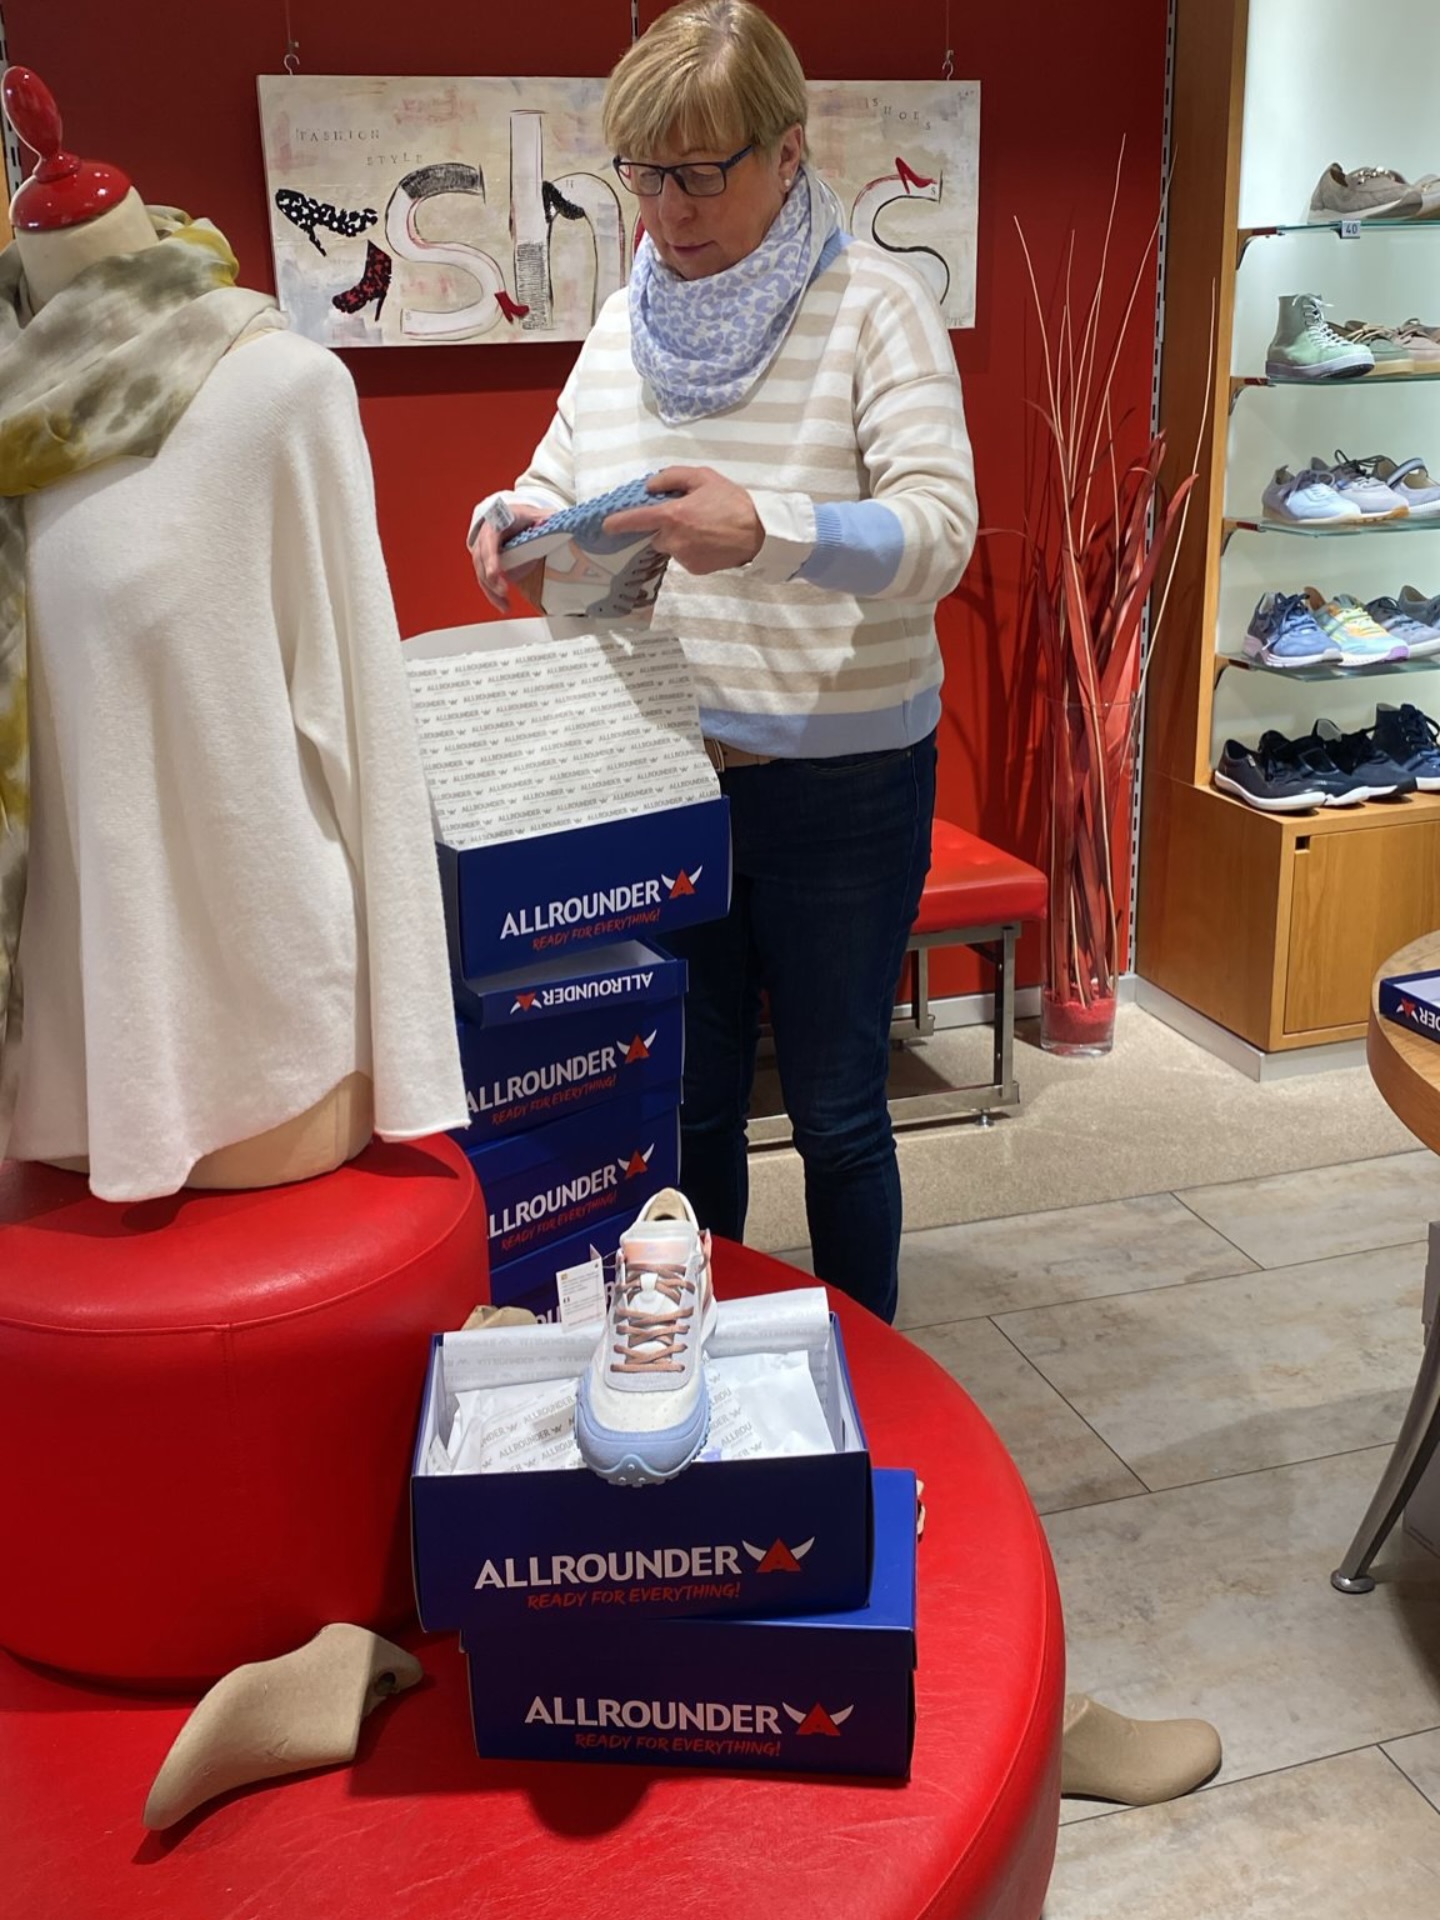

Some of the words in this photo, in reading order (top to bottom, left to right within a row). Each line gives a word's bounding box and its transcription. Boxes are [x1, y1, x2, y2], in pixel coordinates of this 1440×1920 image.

[1345, 223, 1358, 234] 40
[500, 879, 661, 940] ALLROUNDER
[532, 931, 569, 951] READY
[572, 926, 592, 940] FOR
[594, 909, 660, 936] EVERYTHING!
[542, 972, 653, 1006] ALLROUNDER
[467, 1046, 617, 1114] ALLROUNDER
[492, 1107, 527, 1125] READY
[531, 1097, 549, 1111] FOR
[550, 1074, 617, 1106] EVERYTHING!
[488, 1164, 618, 1240] LLROUNDER
[474, 1545, 742, 1590] ALLROUNDER
[527, 1592, 586, 1609] READY
[592, 1589, 625, 1605] FOR
[629, 1582, 741, 1604] EVERYTHING!
[524, 1696, 782, 1734] ALLROUNDER
[575, 1733, 631, 1748] READY
[634, 1735, 669, 1751] FOR
[673, 1737, 781, 1757] EVERYTHING!
